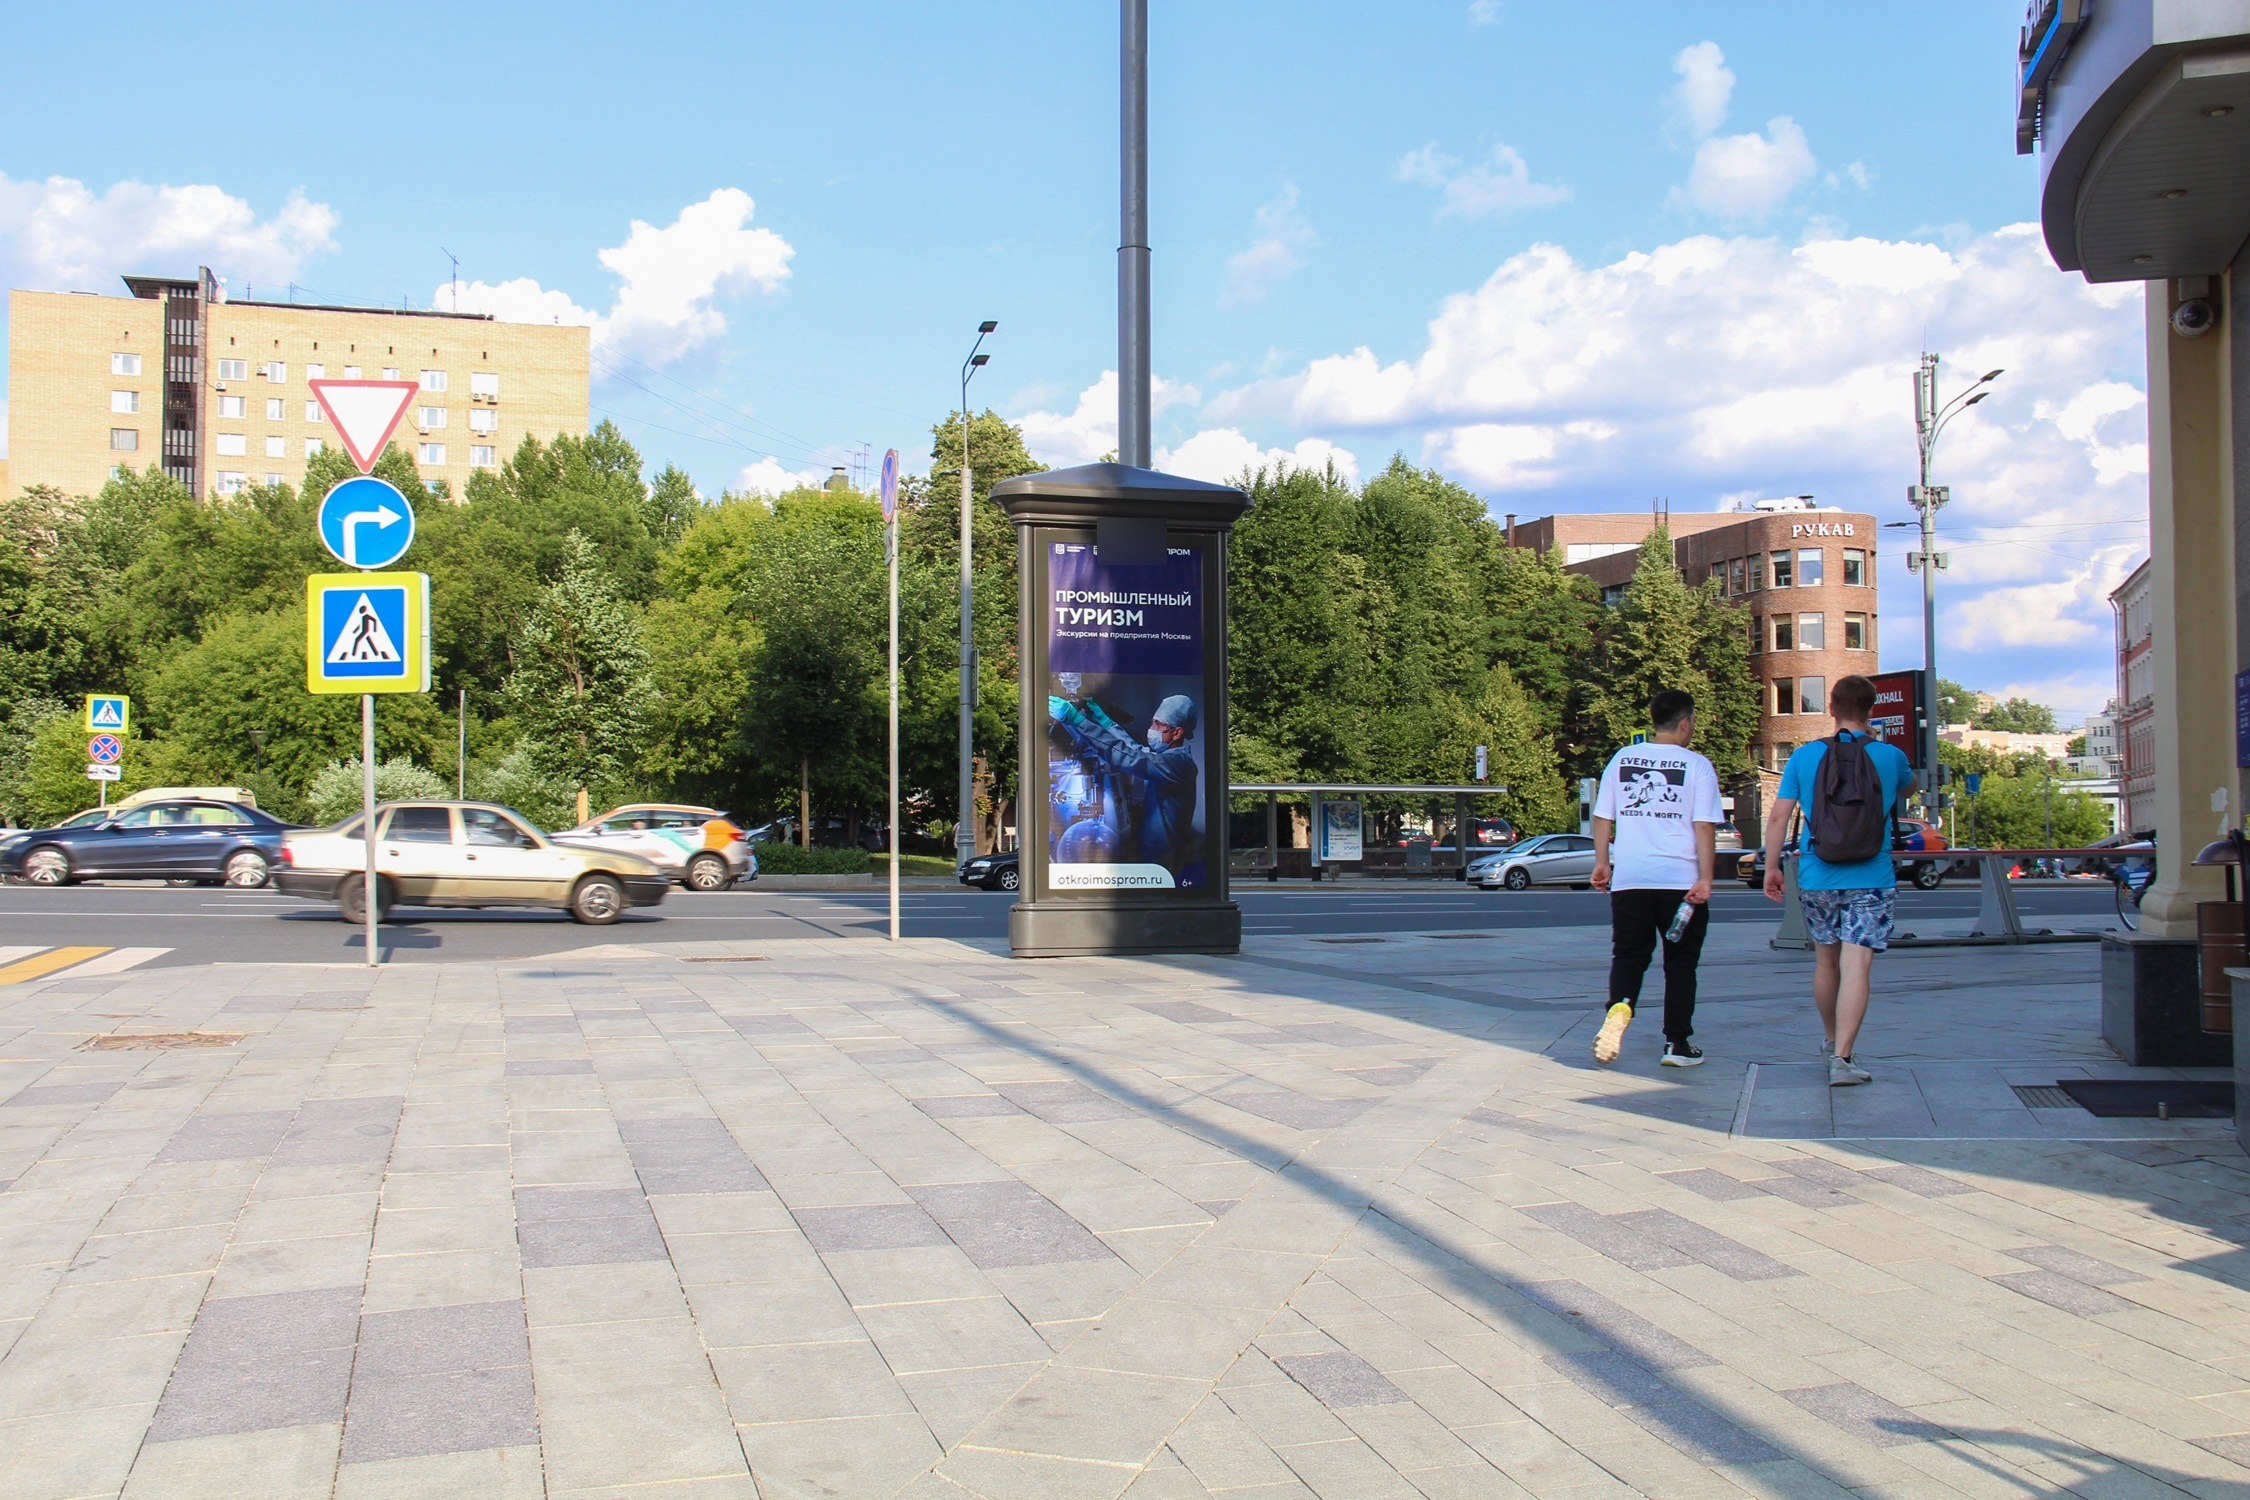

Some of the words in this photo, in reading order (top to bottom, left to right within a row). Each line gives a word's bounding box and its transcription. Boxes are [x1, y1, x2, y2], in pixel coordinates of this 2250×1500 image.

[1791, 523, 1855, 538] РУКАВ
[1166, 548, 1191, 556] ПРОМ
[1055, 590, 1192, 606] ПРОМЫШЛЕННЫЙ
[1055, 607, 1144, 627] ТУРИЗМ
[1056, 629, 1098, 639] Экскурсии
[1110, 632, 1160, 640] предприятия
[1161, 632, 1192, 640] Москвы
[1874, 691, 1904, 704] OXHALL
[1620, 757, 1657, 768] EVERY
[1660, 760, 1688, 769] RICK
[1646, 810, 1652, 818] A
[1654, 811, 1683, 819] MORTY
[1058, 874, 1163, 887] otkroimosprom.ru
[1182, 879, 1193, 887] 6+
